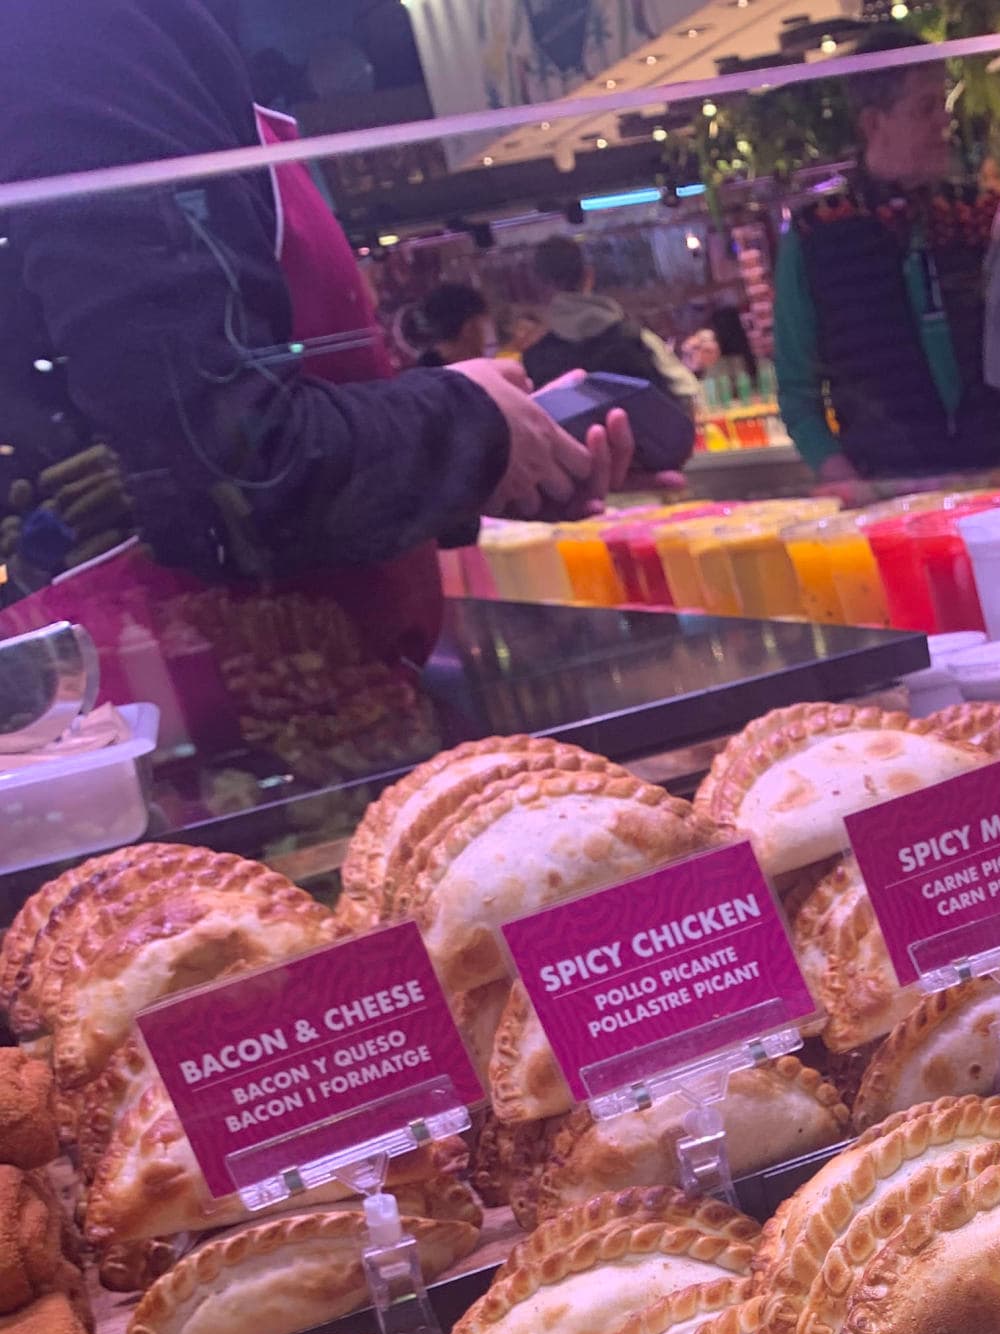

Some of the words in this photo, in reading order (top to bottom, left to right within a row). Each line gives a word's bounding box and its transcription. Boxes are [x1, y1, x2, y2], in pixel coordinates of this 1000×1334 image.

[898, 825, 971, 872] SPICY
[921, 866, 979, 899] CARNE
[937, 887, 986, 916] CARN
[540, 941, 622, 992] SPICY
[631, 893, 761, 958] CHICKEN
[595, 976, 657, 1011] POLLO
[660, 946, 738, 987] PICANTE
[179, 1028, 288, 1085] BACON
[294, 1018, 320, 1044] &
[324, 979, 425, 1031] CHEESE
[587, 988, 692, 1038] POLLASTRE
[693, 961, 760, 999] PICANT
[224, 1091, 303, 1133] BACON
[306, 1086, 317, 1103] I
[319, 1045, 432, 1100] FORMATGE
[232, 1063, 310, 1105] BACON
[312, 1055, 328, 1075] Y
[333, 1030, 406, 1069] QUESO
